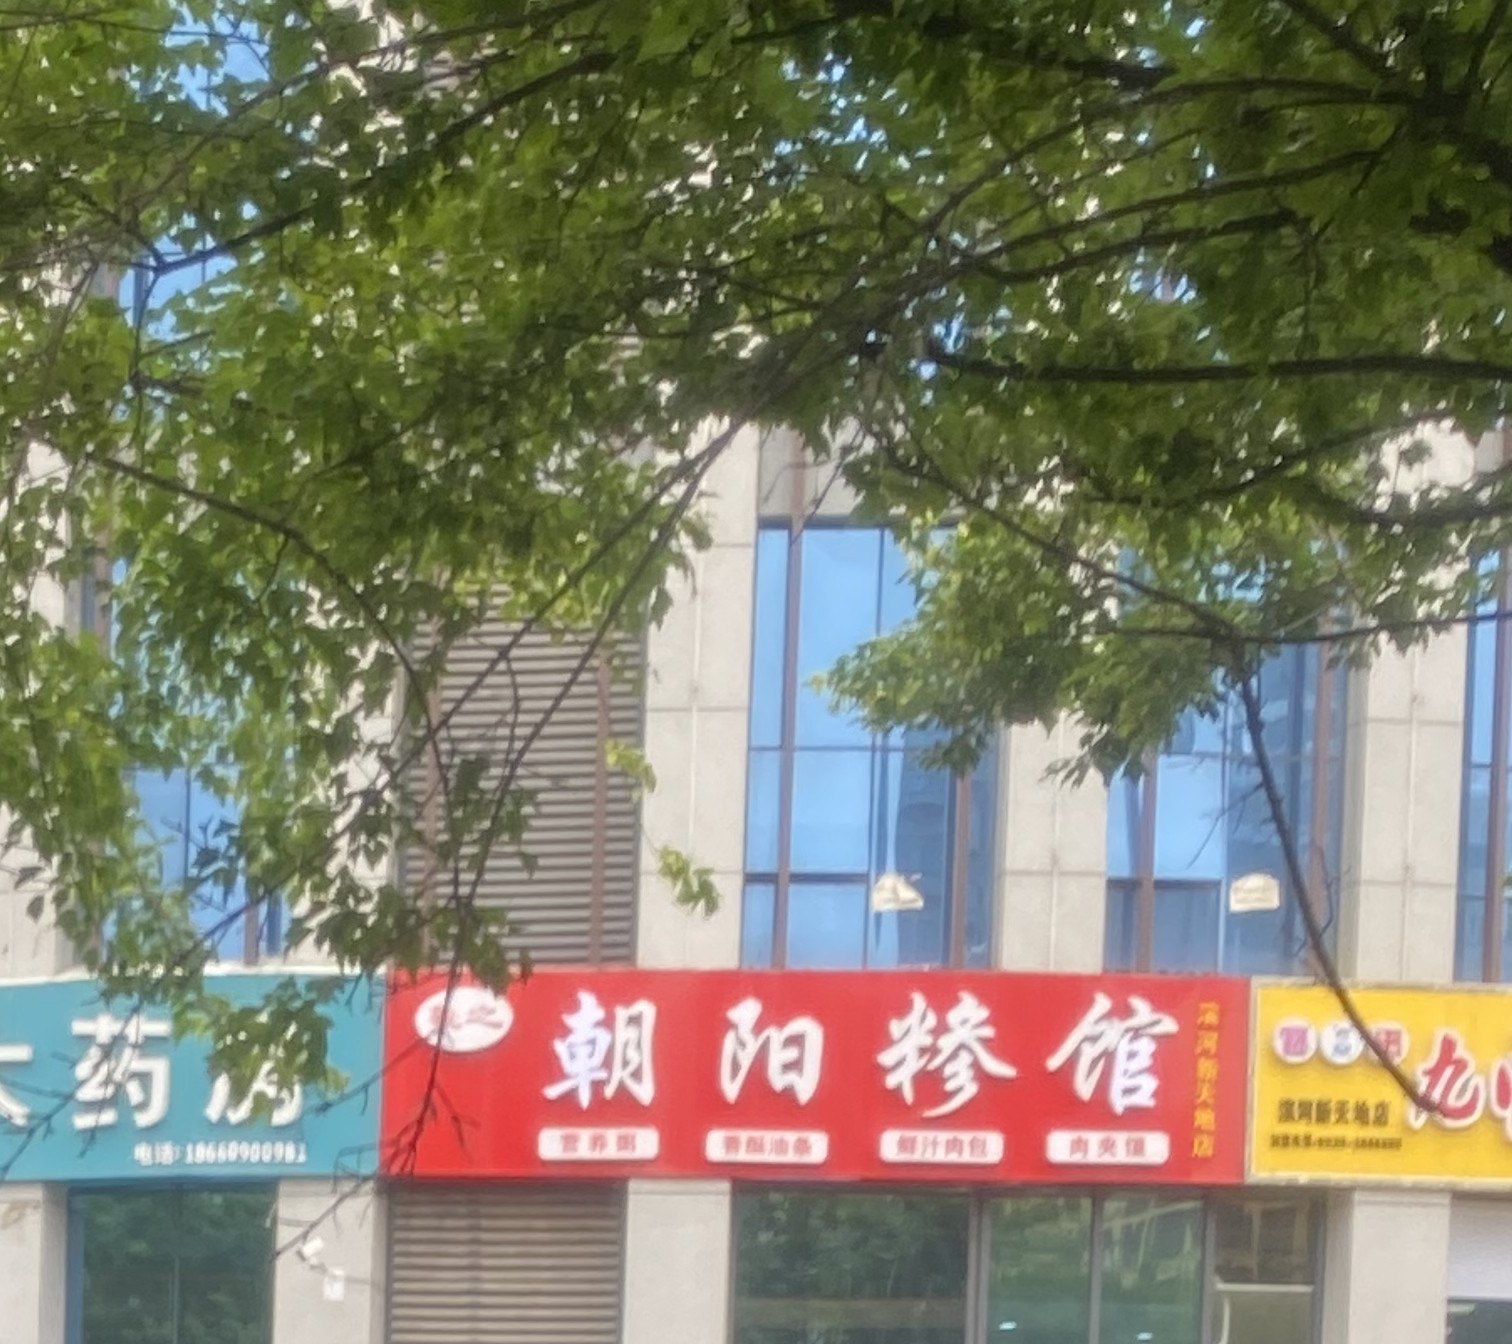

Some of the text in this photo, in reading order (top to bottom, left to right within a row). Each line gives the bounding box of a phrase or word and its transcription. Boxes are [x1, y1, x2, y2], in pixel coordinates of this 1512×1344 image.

[544, 990, 1180, 1118] 朝阳糁馆
[1410, 1031, 1512, 1130] 九
